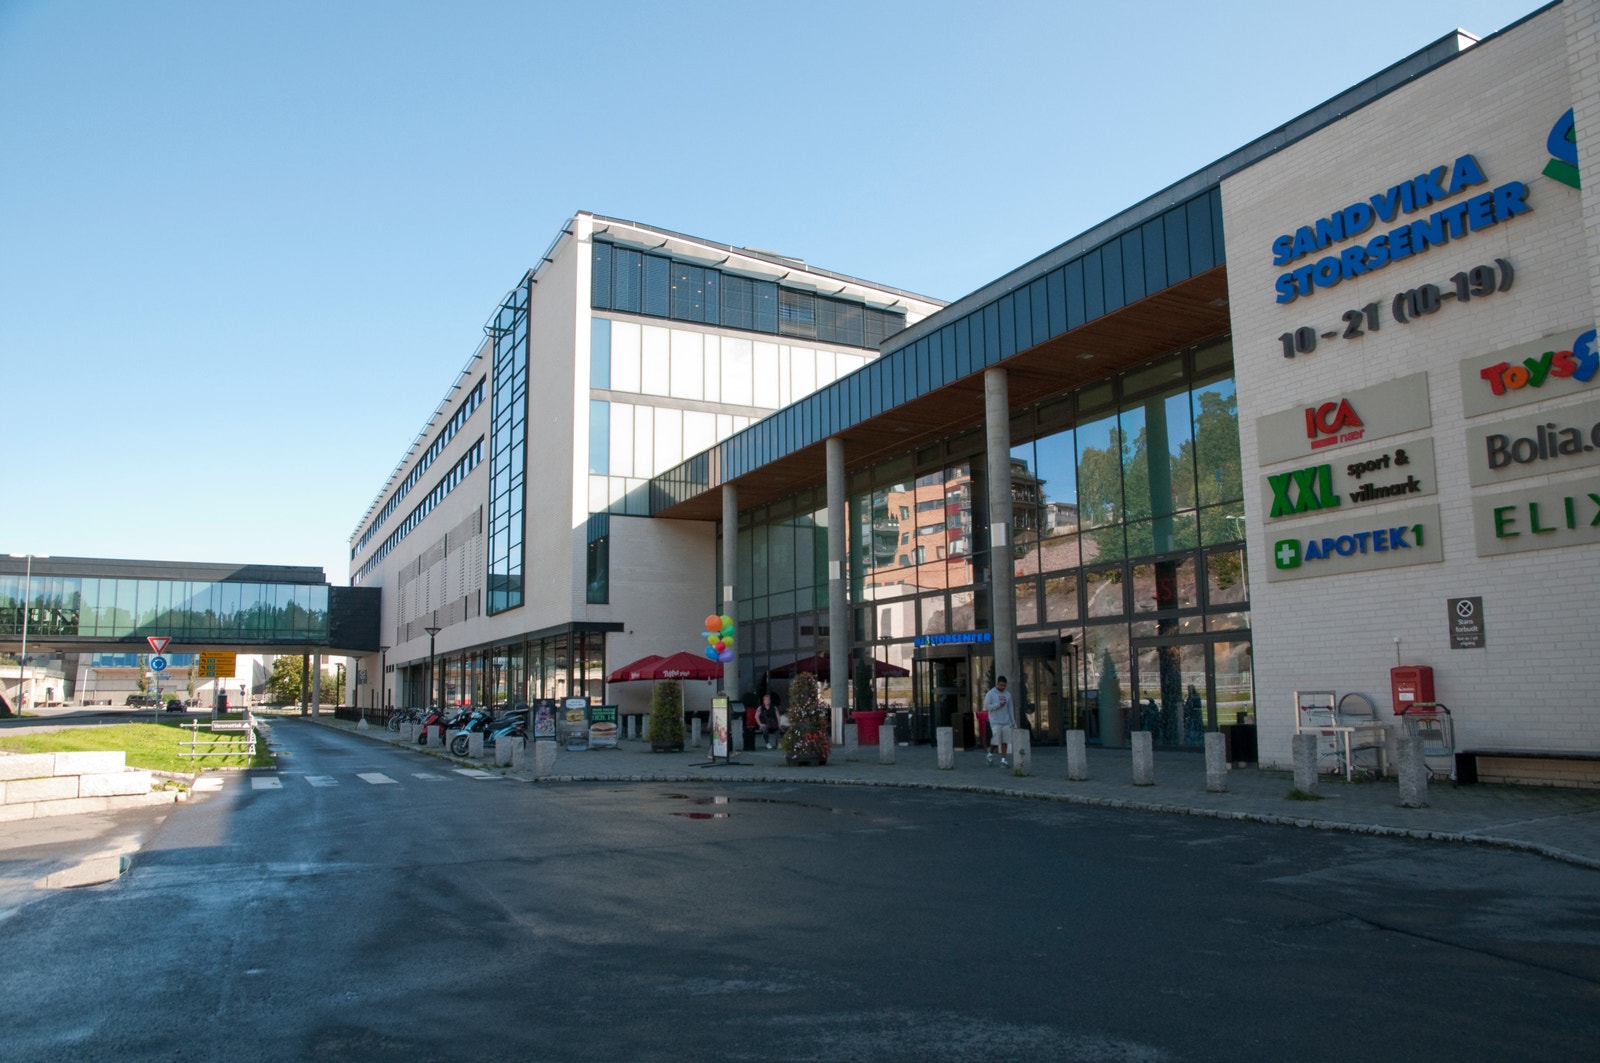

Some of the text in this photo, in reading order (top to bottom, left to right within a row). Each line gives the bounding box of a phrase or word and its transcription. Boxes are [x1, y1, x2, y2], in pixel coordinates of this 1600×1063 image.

[1272, 154, 1488, 266] SANDVIKA
[1275, 181, 1533, 304] STORSENTER
[1305, 398, 1363, 438] ICA
[1347, 449, 1410, 478] sport &
[1267, 464, 1341, 518] XXL
[1349, 475, 1420, 503] villmark
[930, 632, 991, 645] STORSENTER
[1455, 625, 1479, 633] forbudt
